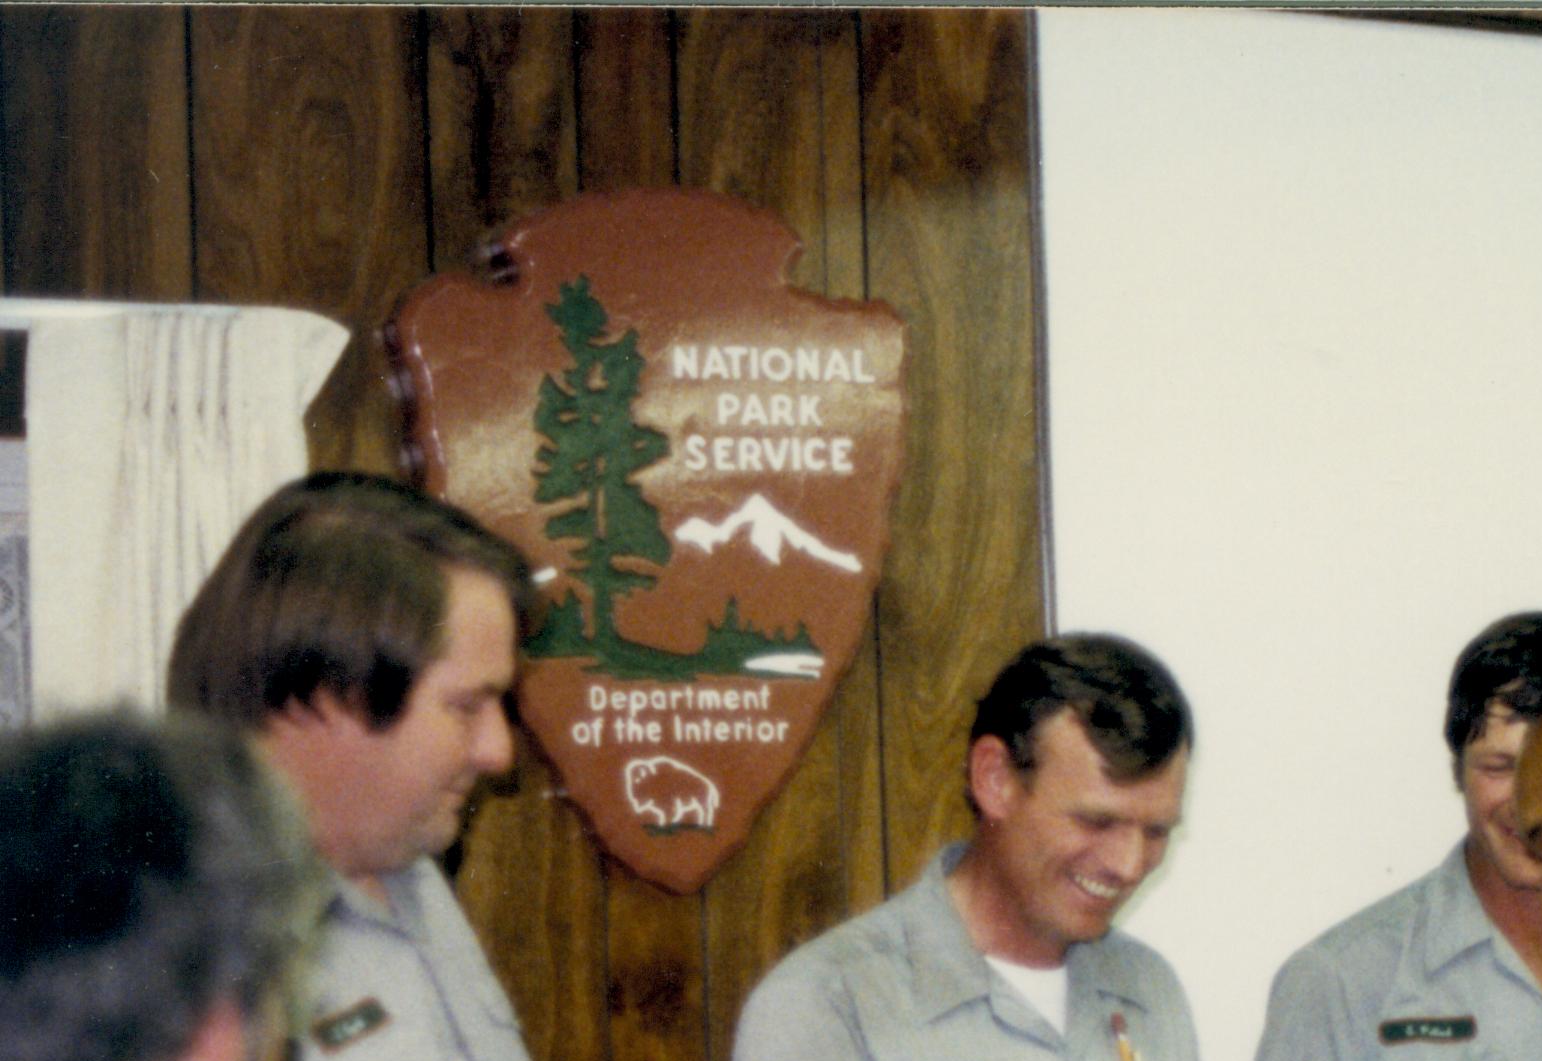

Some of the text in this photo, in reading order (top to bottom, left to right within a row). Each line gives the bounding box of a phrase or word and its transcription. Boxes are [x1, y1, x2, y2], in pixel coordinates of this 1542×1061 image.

[672, 346, 876, 383] NATIONAL
[717, 392, 823, 426] PARK
[685, 434, 854, 471] SERVICE
[589, 684, 770, 717] Department
[571, 715, 789, 747] of the Interior
